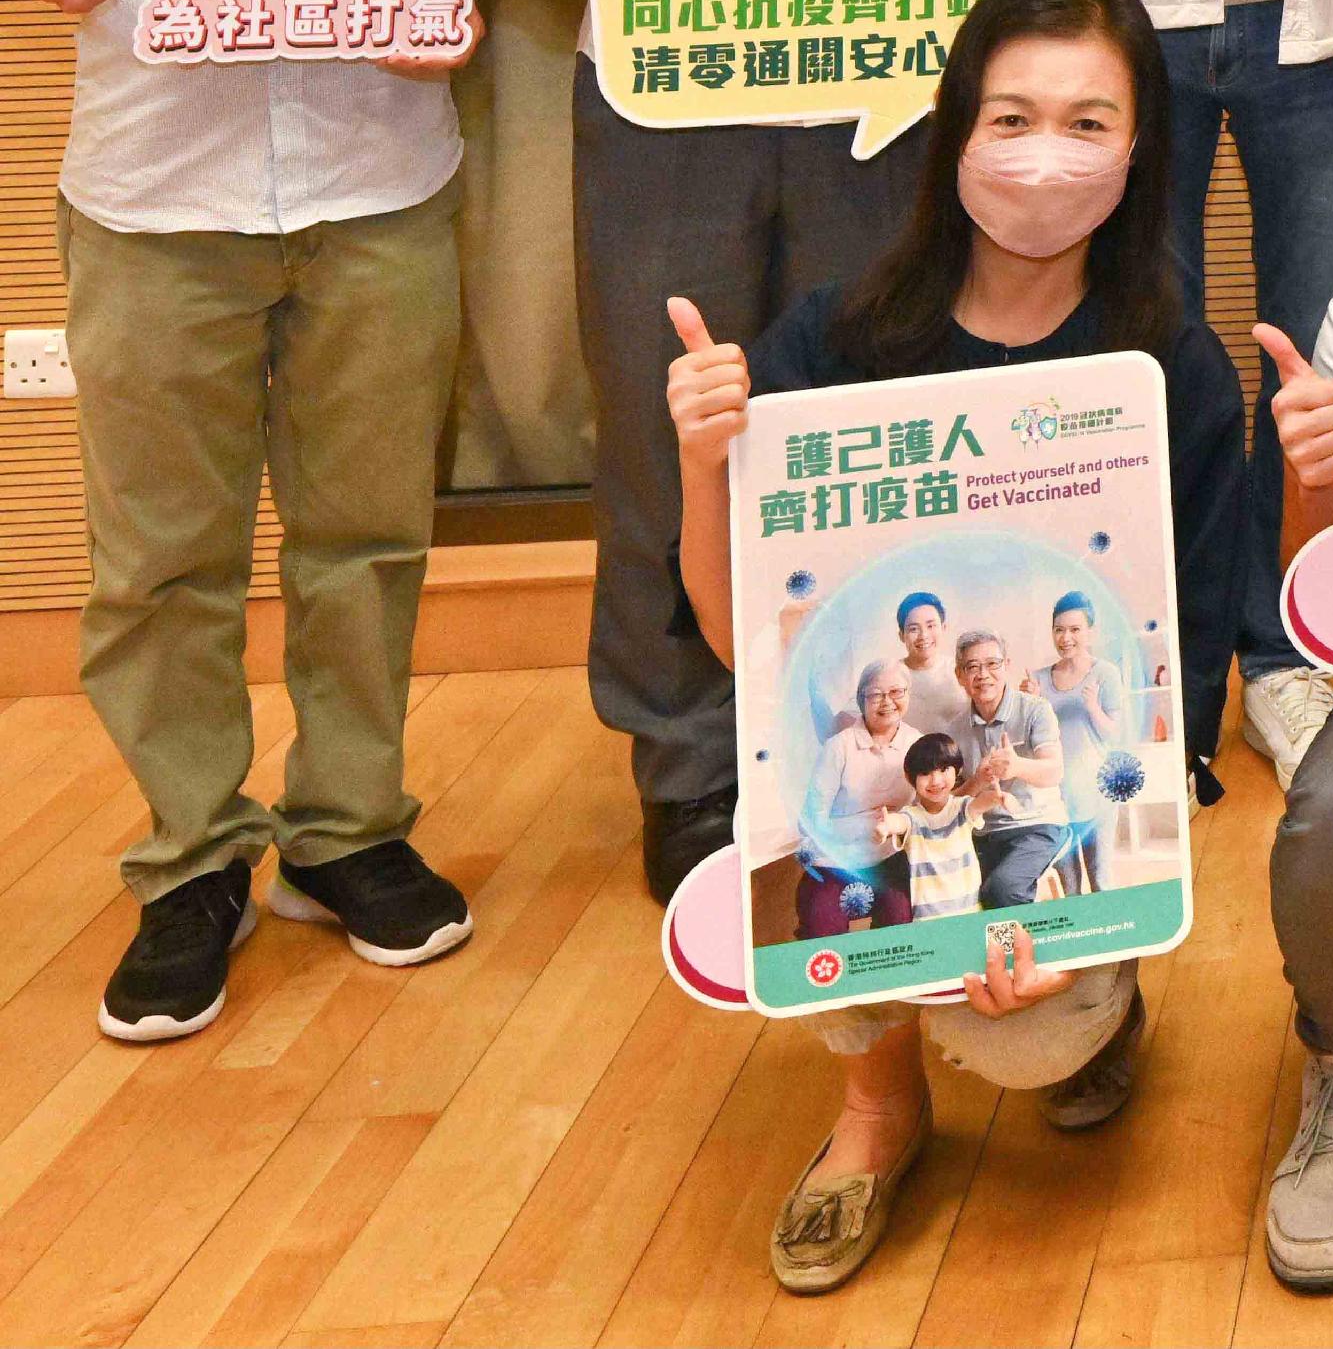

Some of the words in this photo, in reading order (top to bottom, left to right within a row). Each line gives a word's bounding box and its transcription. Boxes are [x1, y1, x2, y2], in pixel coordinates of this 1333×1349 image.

[631, 30, 947, 95] 清零通關安心
[785, 413, 985, 481] 護己護人
[967, 470, 1016, 487] Protect
[1019, 462, 1075, 485] yourself
[1078, 459, 1102, 473] and
[1106, 455, 1150, 470] others
[759, 470, 959, 539] 齊打疫苗
[967, 492, 999, 511] Get
[1002, 477, 1101, 506] Vaccinated
